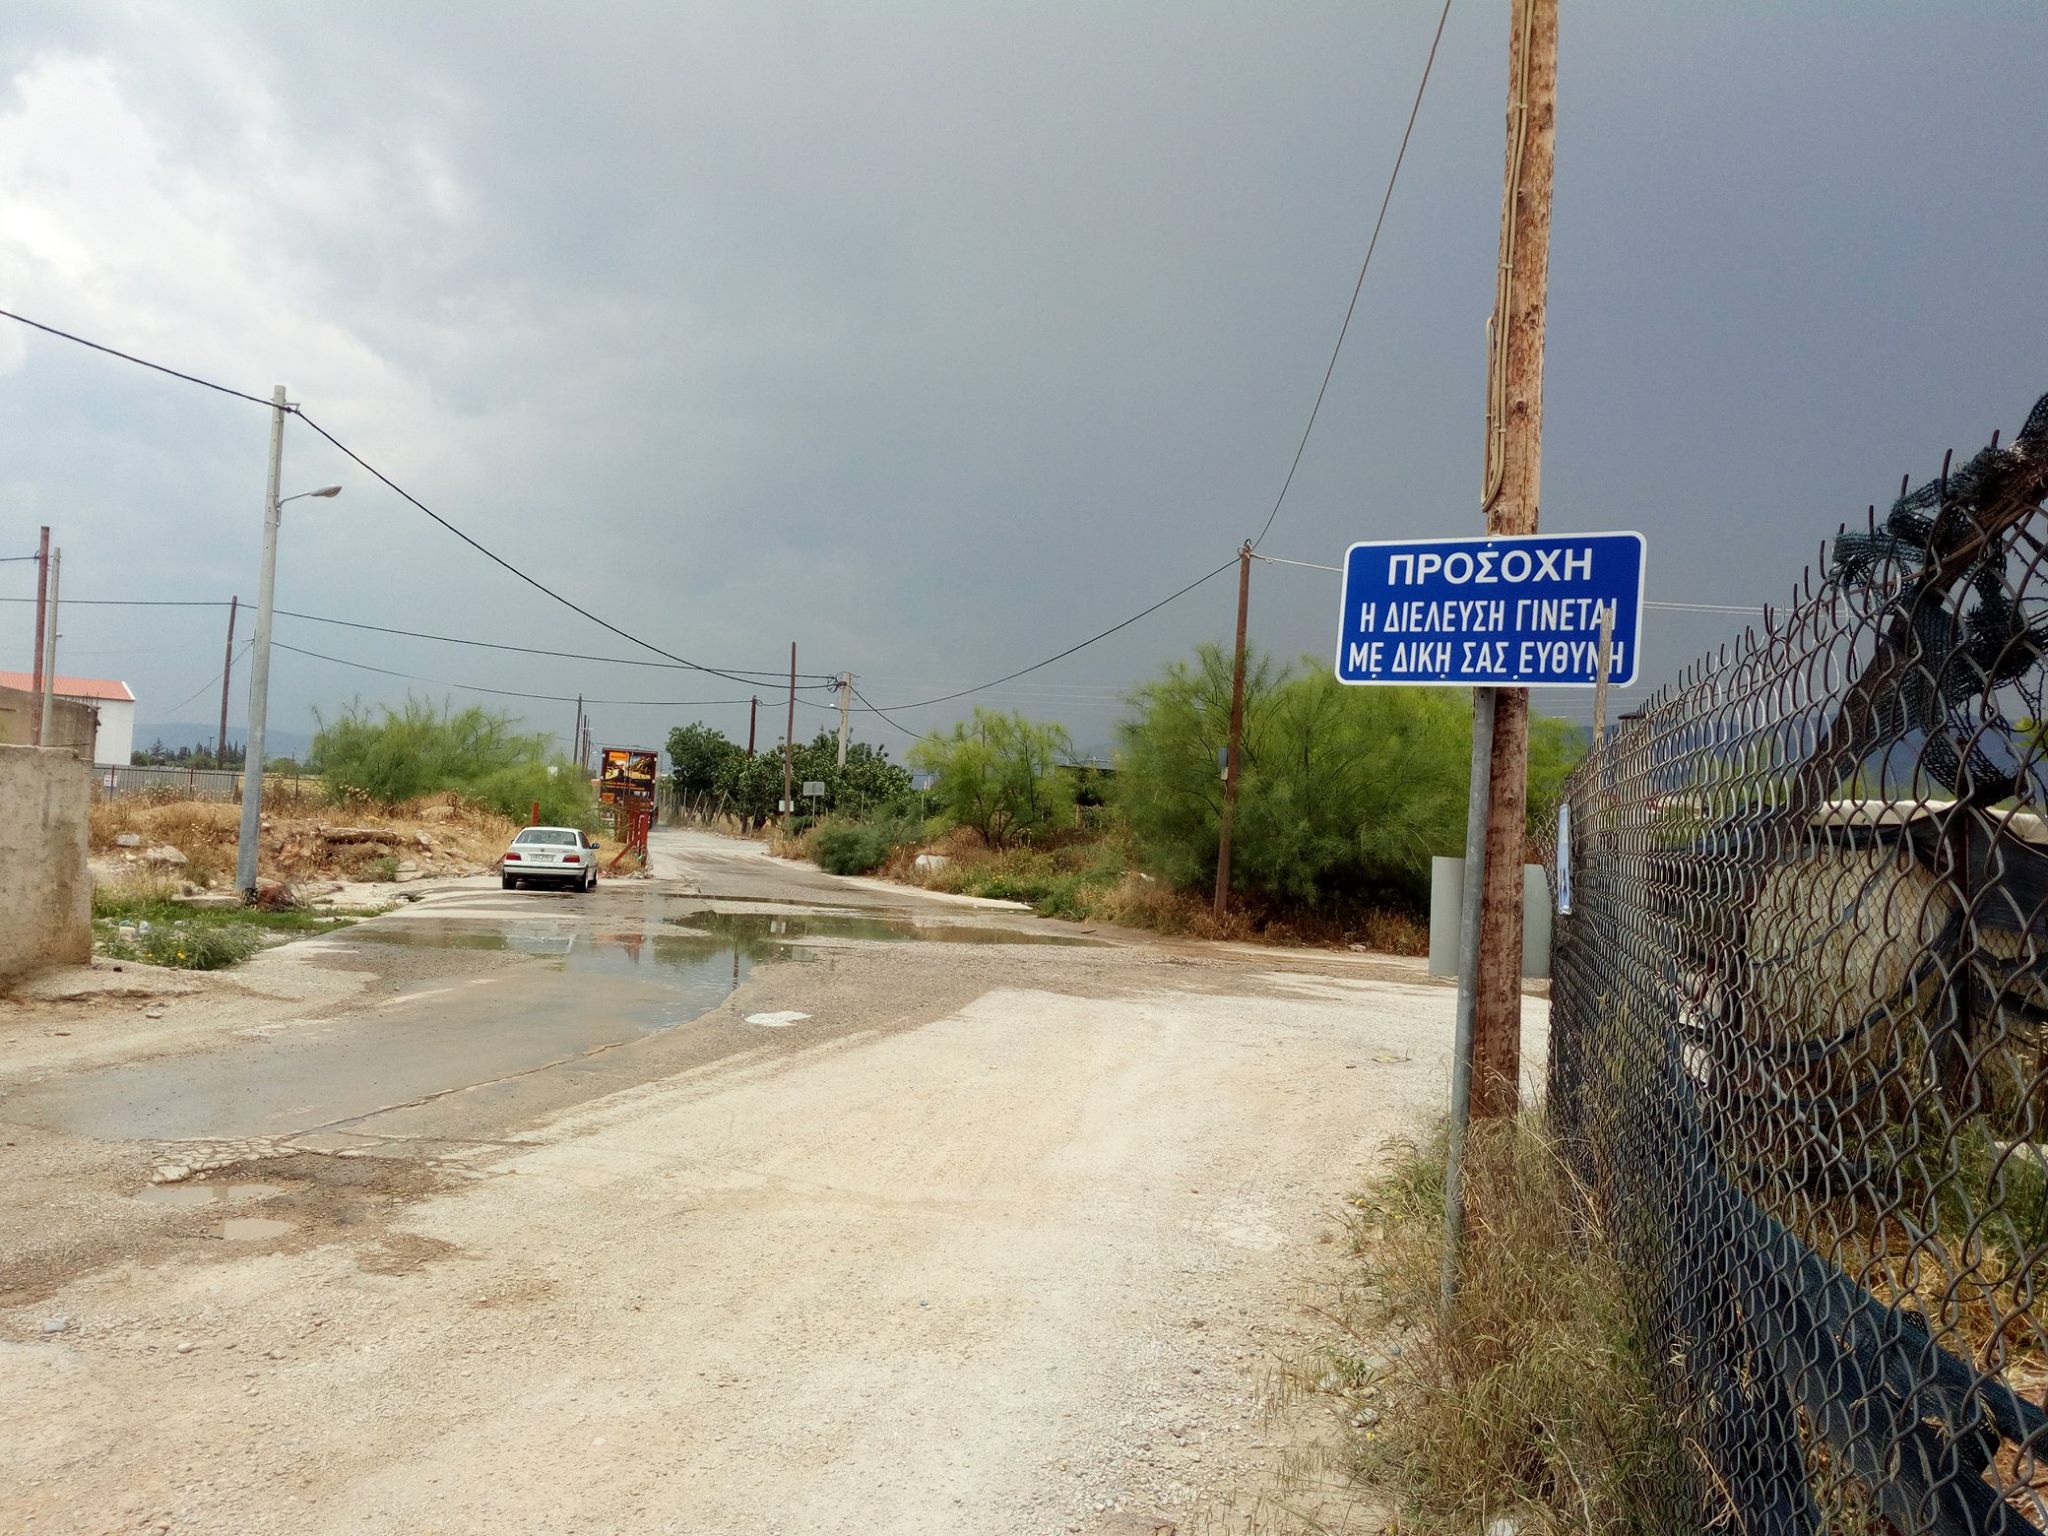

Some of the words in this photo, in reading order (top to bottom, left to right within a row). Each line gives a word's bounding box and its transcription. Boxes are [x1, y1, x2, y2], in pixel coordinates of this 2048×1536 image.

[1388, 547, 1593, 586] ΠΡΟΣΟΧΗ
[1360, 602, 1376, 633] Η
[1383, 599, 1506, 633] ΔΙΕΛΕΥΣΗ
[1515, 597, 1618, 632] ΓΙΝΕΤΑΙ
[1348, 641, 1385, 673] ΜΕ
[1391, 641, 1452, 673] ΔΙΚΗ
[1460, 641, 1510, 674] ΣΑΣ
